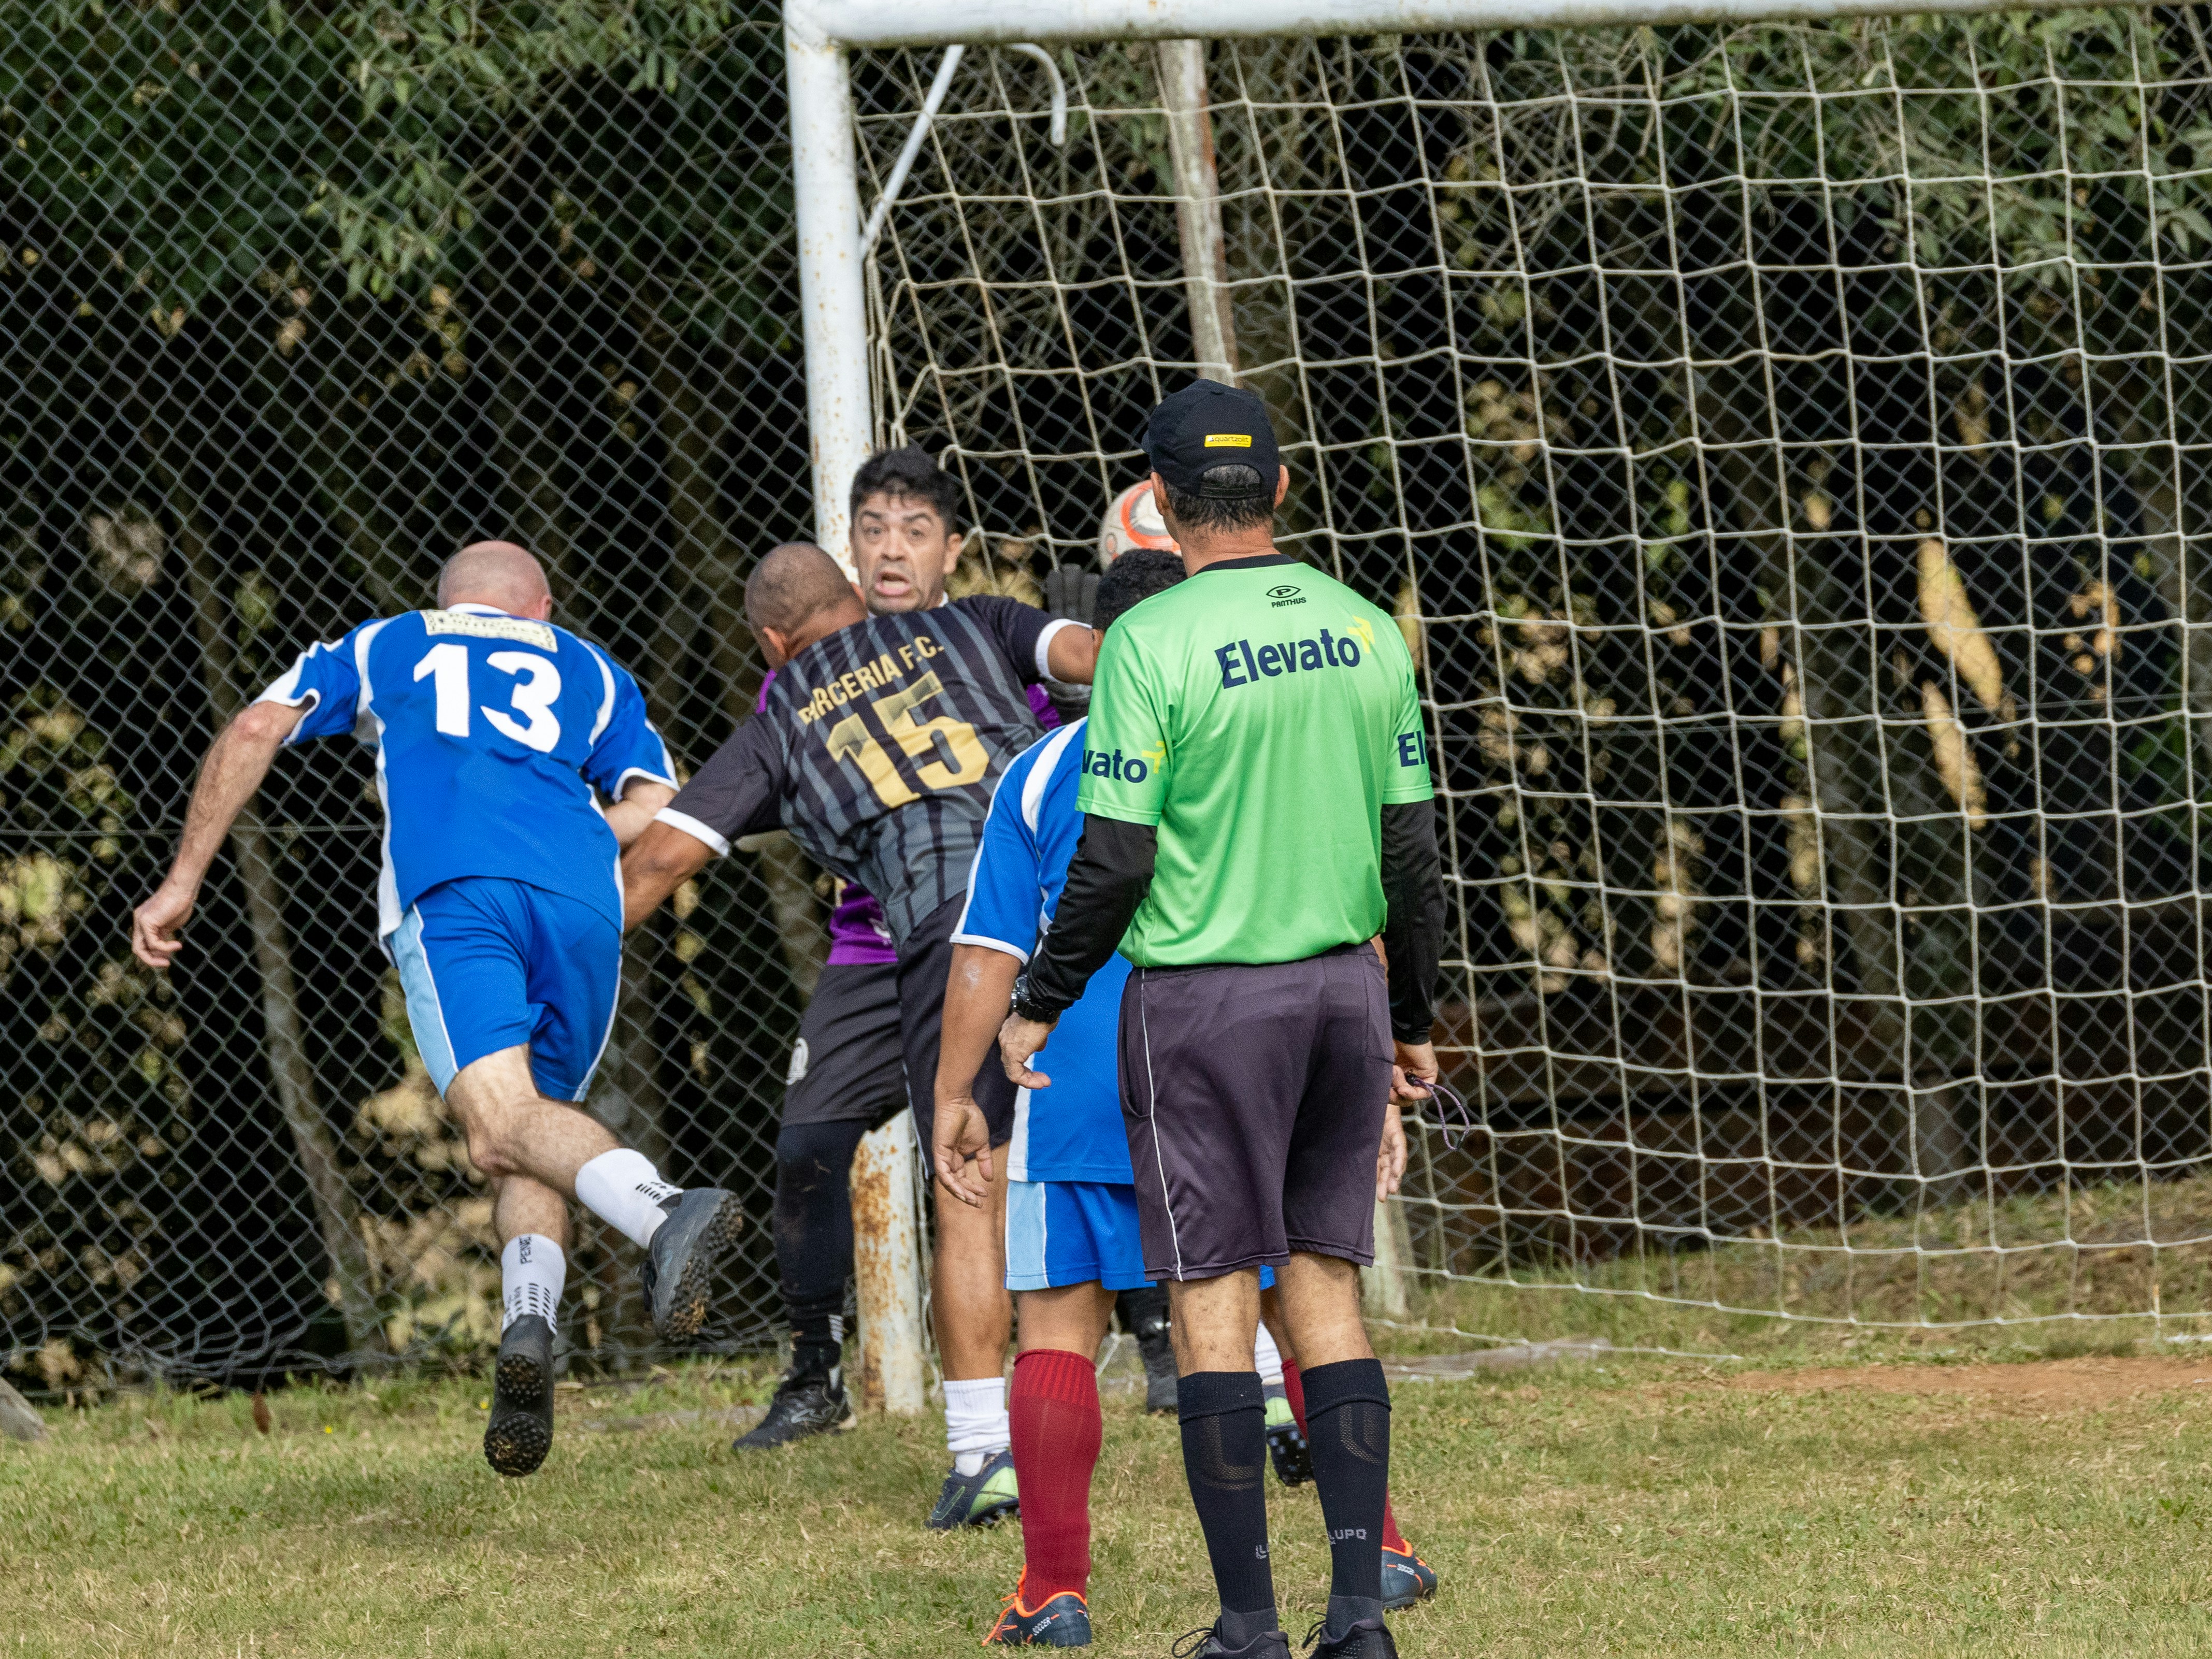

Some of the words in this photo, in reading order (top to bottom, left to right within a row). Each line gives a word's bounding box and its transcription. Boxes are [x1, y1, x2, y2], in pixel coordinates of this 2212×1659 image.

[1271, 597, 1307, 608] PANTHUS
[898, 636, 945, 670] F.C.
[1215, 628, 1361, 689] Elevato
[413, 643, 562, 754] 13
[826, 670, 990, 809] 15
[1082, 748, 1147, 783] vato
